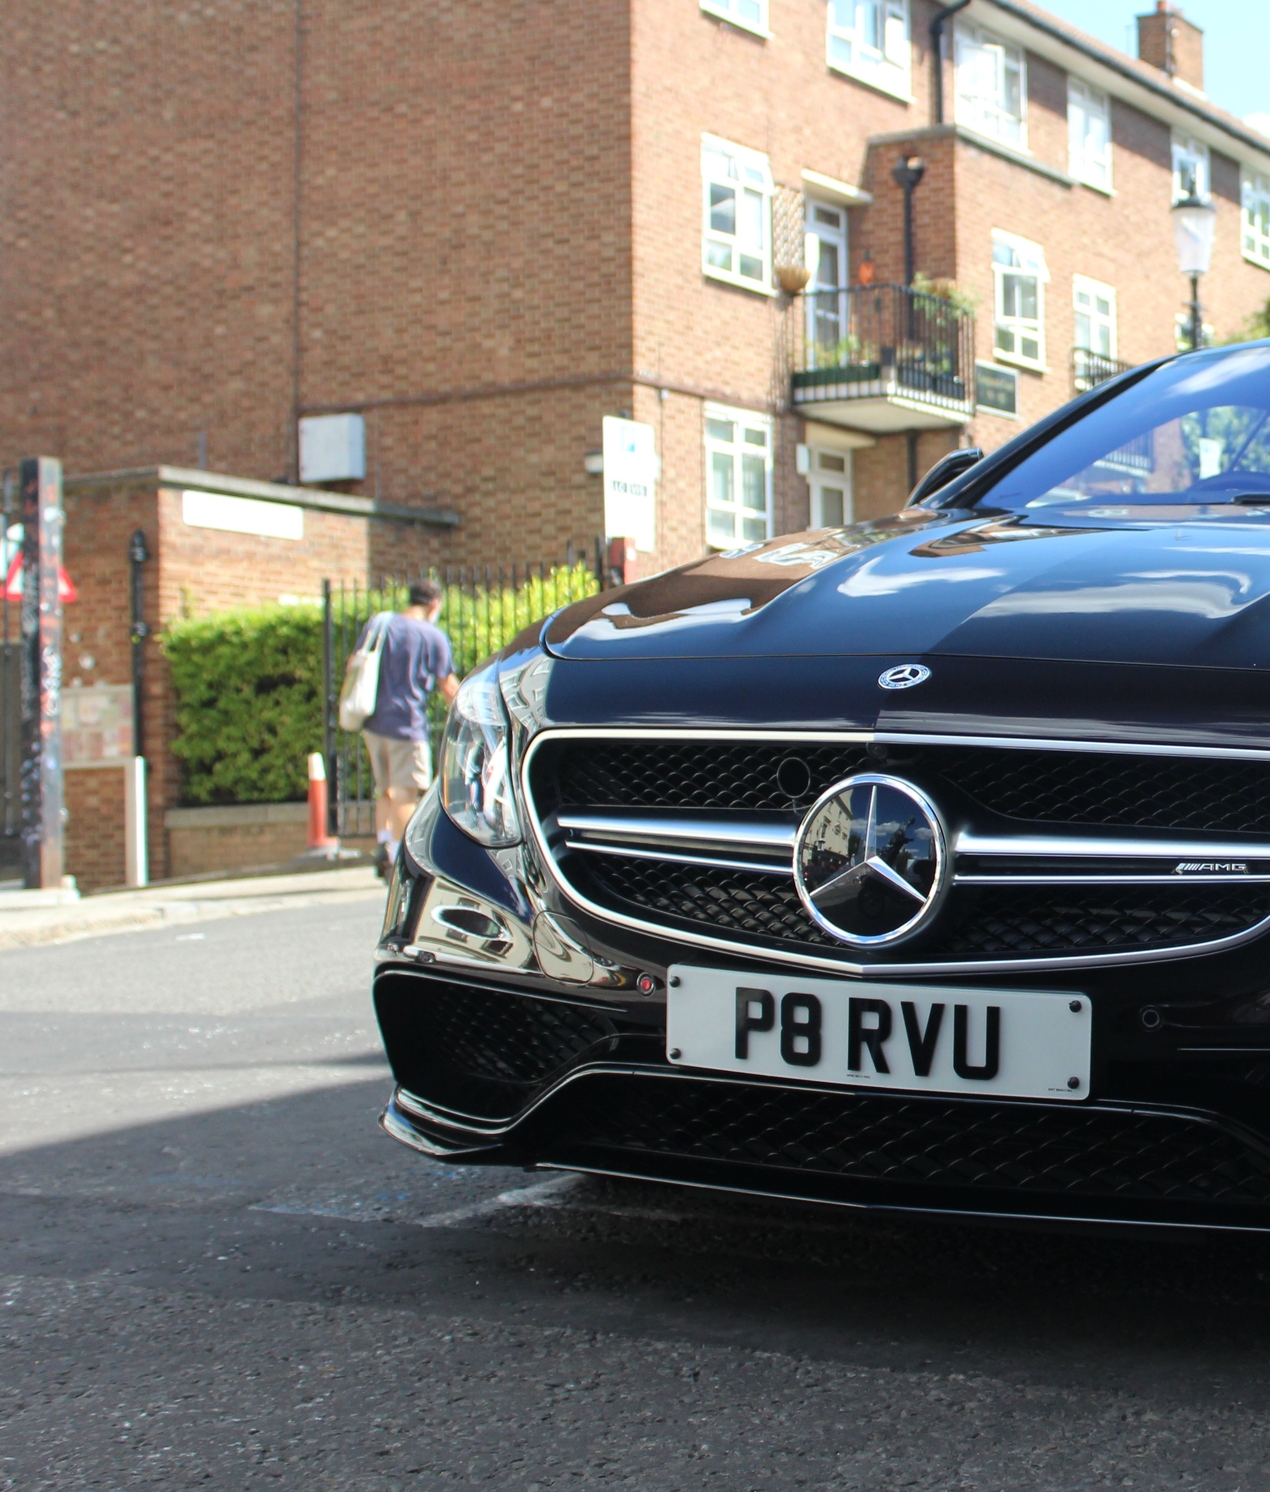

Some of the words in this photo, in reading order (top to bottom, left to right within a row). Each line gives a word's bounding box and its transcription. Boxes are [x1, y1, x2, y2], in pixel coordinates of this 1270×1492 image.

[1198, 863, 1247, 871] AMG
[735, 987, 822, 1067] P8
[847, 997, 1001, 1081] RVU
